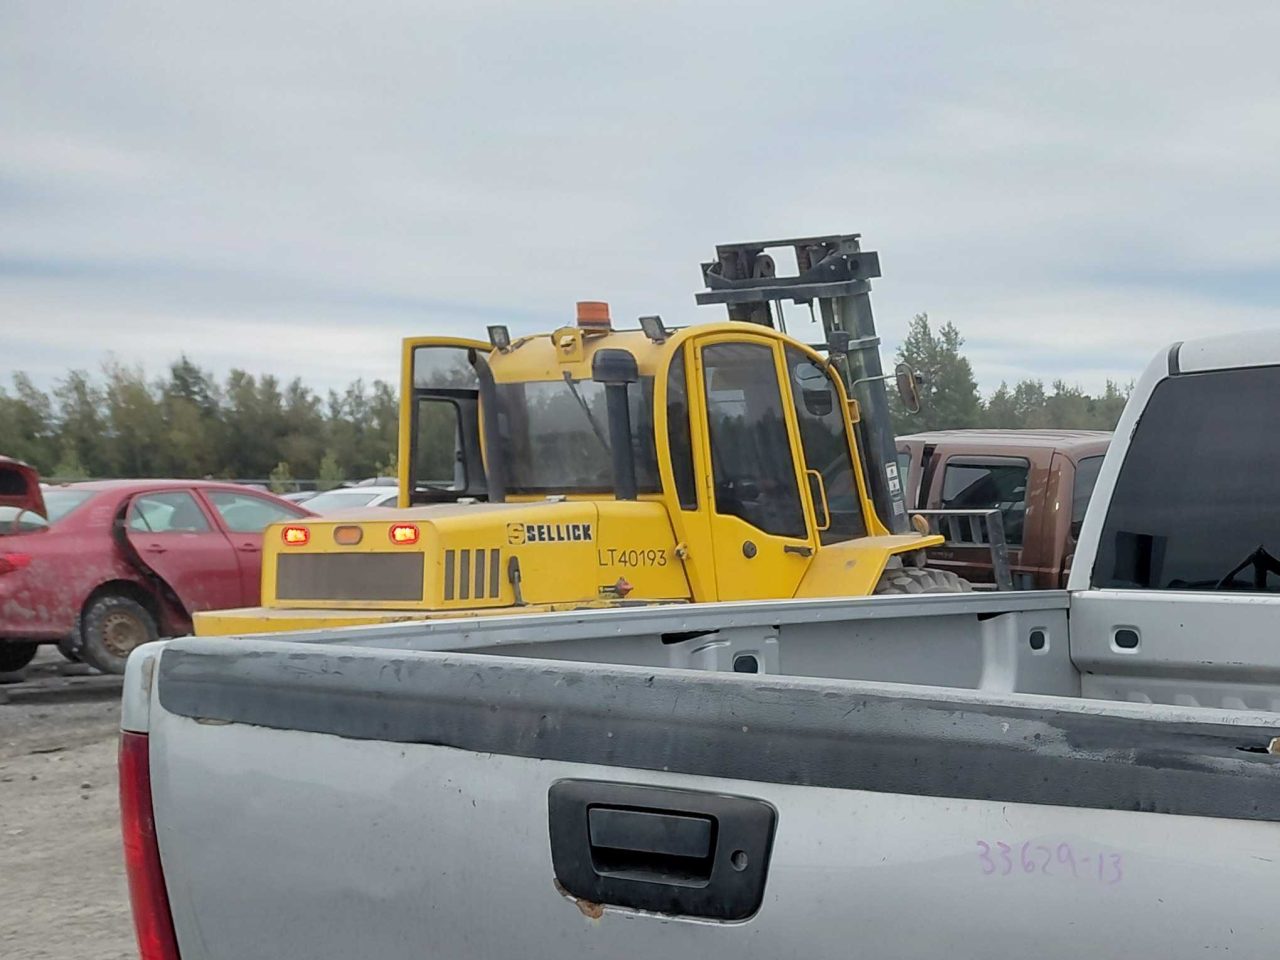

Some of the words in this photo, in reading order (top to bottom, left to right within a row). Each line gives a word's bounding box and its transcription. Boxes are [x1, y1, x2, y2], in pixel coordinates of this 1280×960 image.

[526, 524, 592, 541] SELLICK
[598, 549, 667, 567] LT40193
[977, 840, 1122, 884] 33629-13
